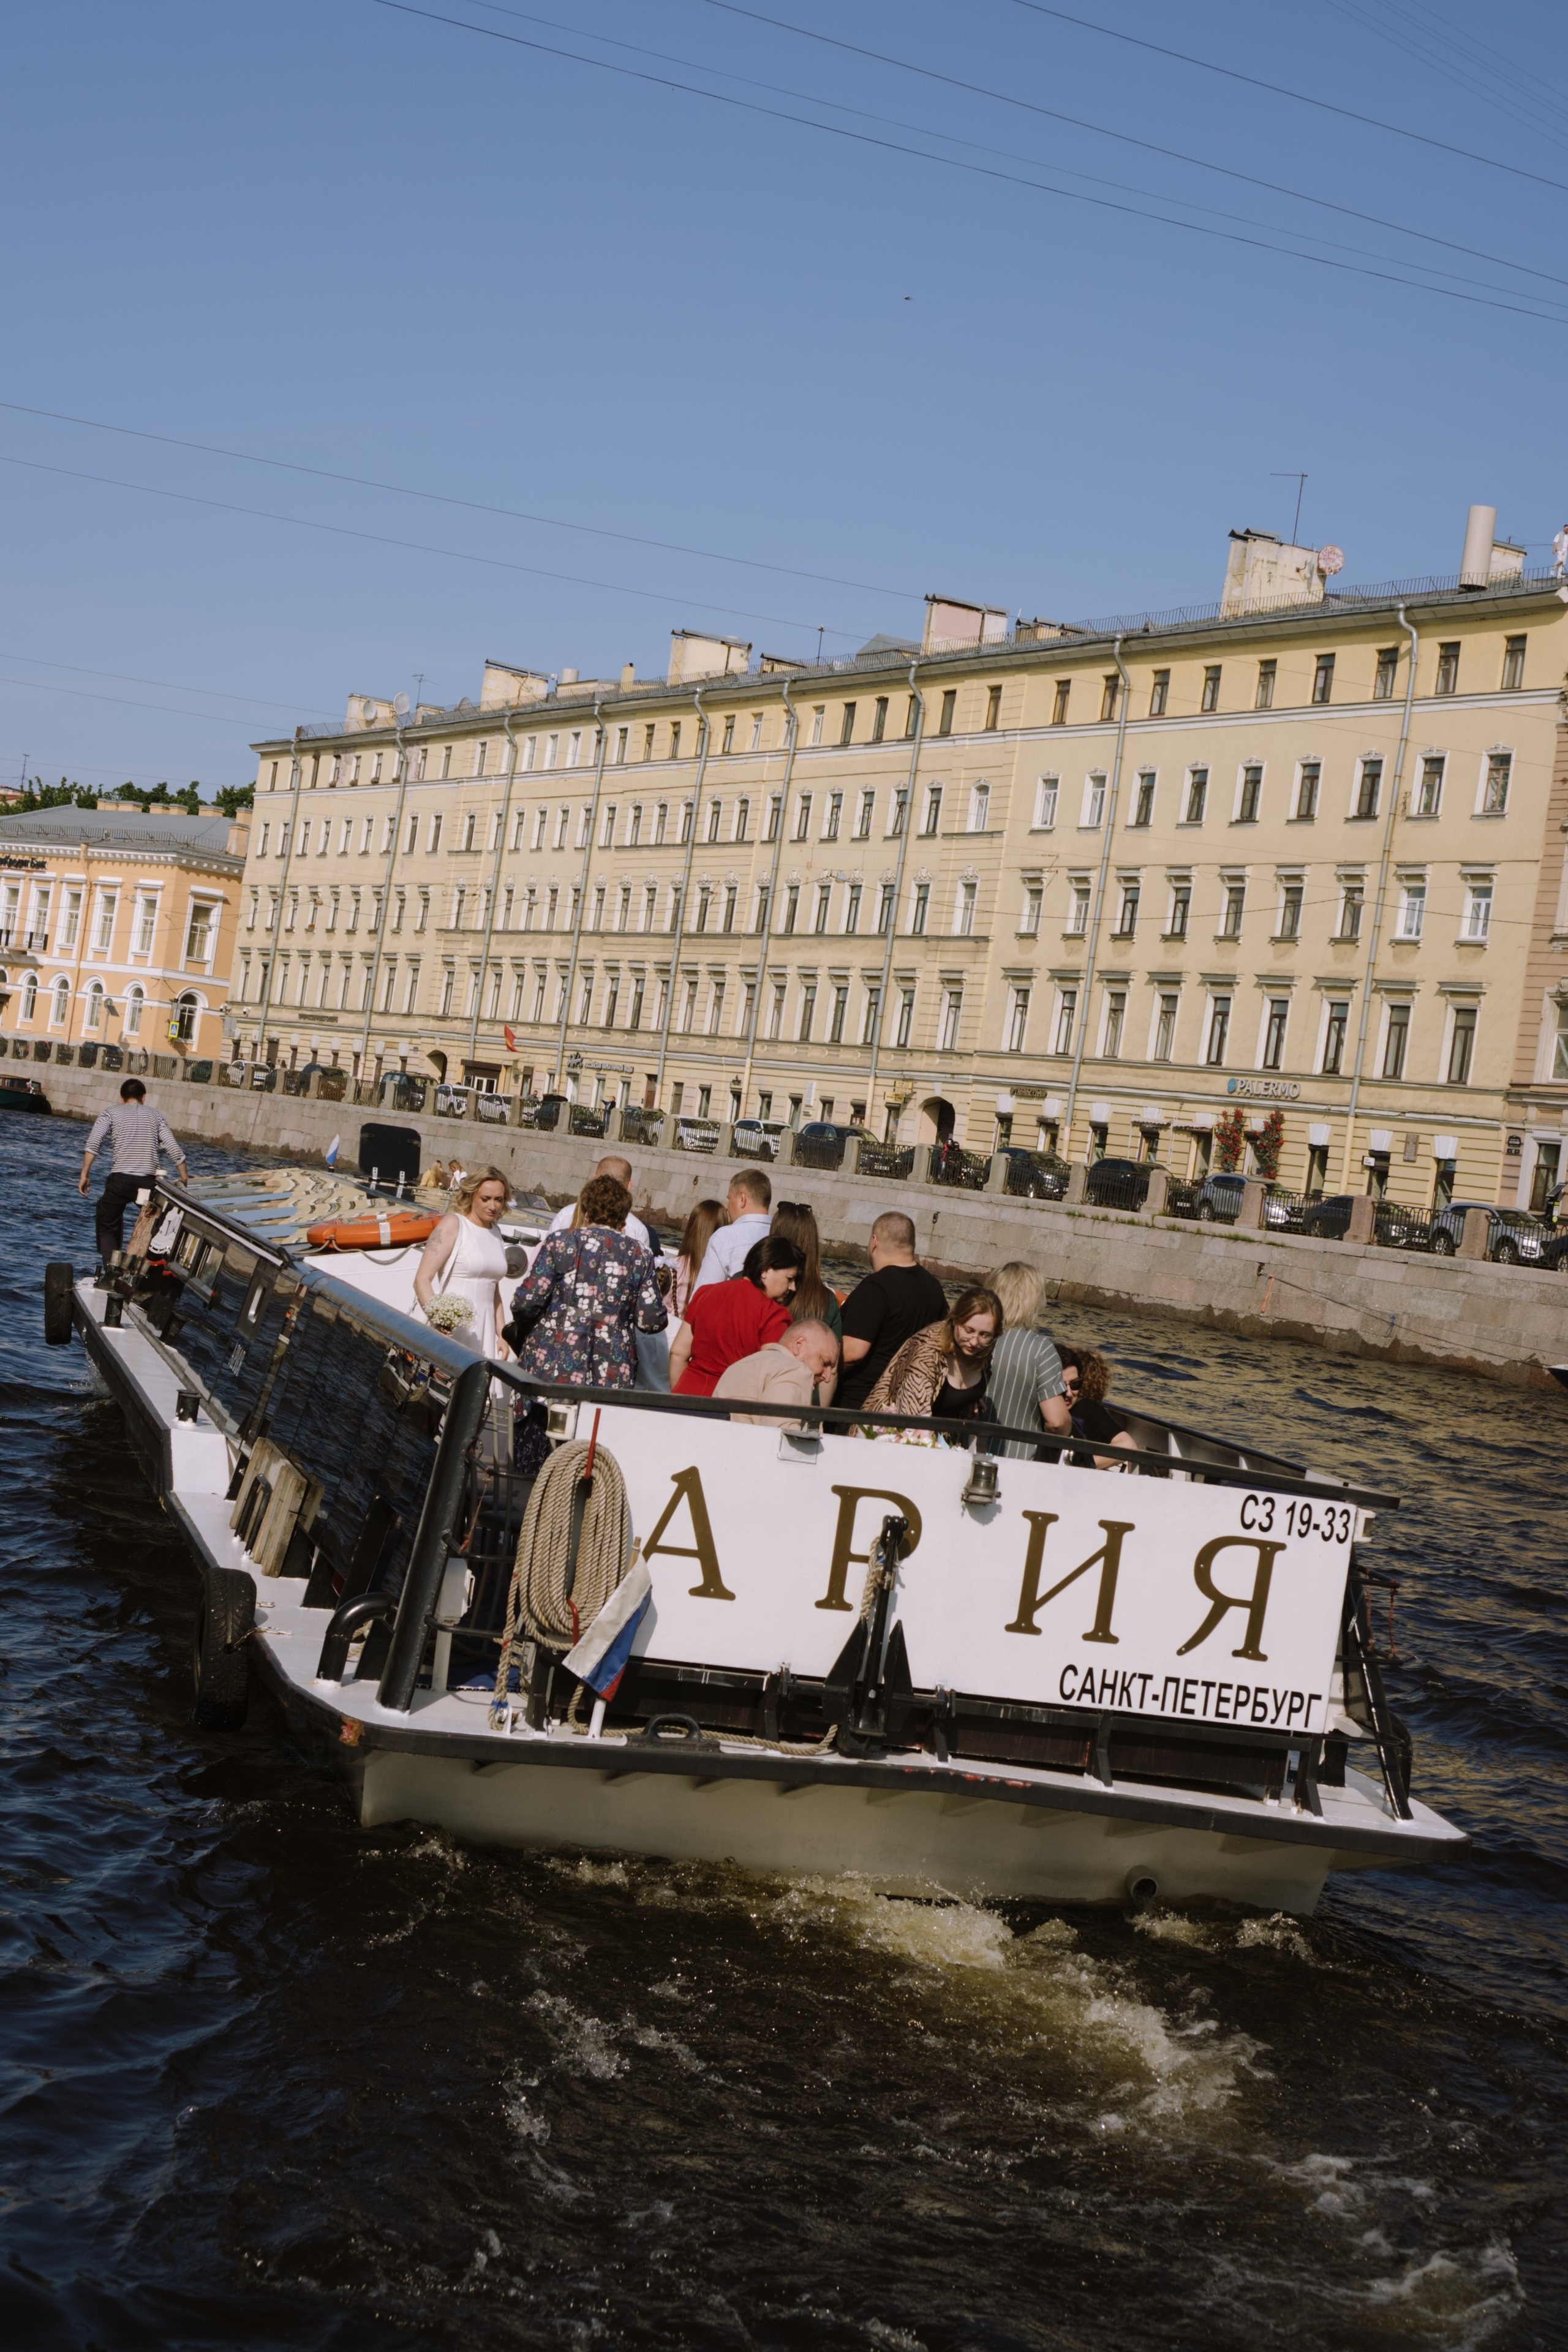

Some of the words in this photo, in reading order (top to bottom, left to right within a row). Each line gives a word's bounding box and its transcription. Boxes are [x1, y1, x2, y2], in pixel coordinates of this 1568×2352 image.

[1237, 1079, 1300, 1098] PALERMO
[1286, 1501, 1351, 1544] 19-33
[642, 1466, 1287, 1662] АРИЯ
[1059, 1664, 1322, 1728] САНКТ-ПЕТЕРБУРГ
